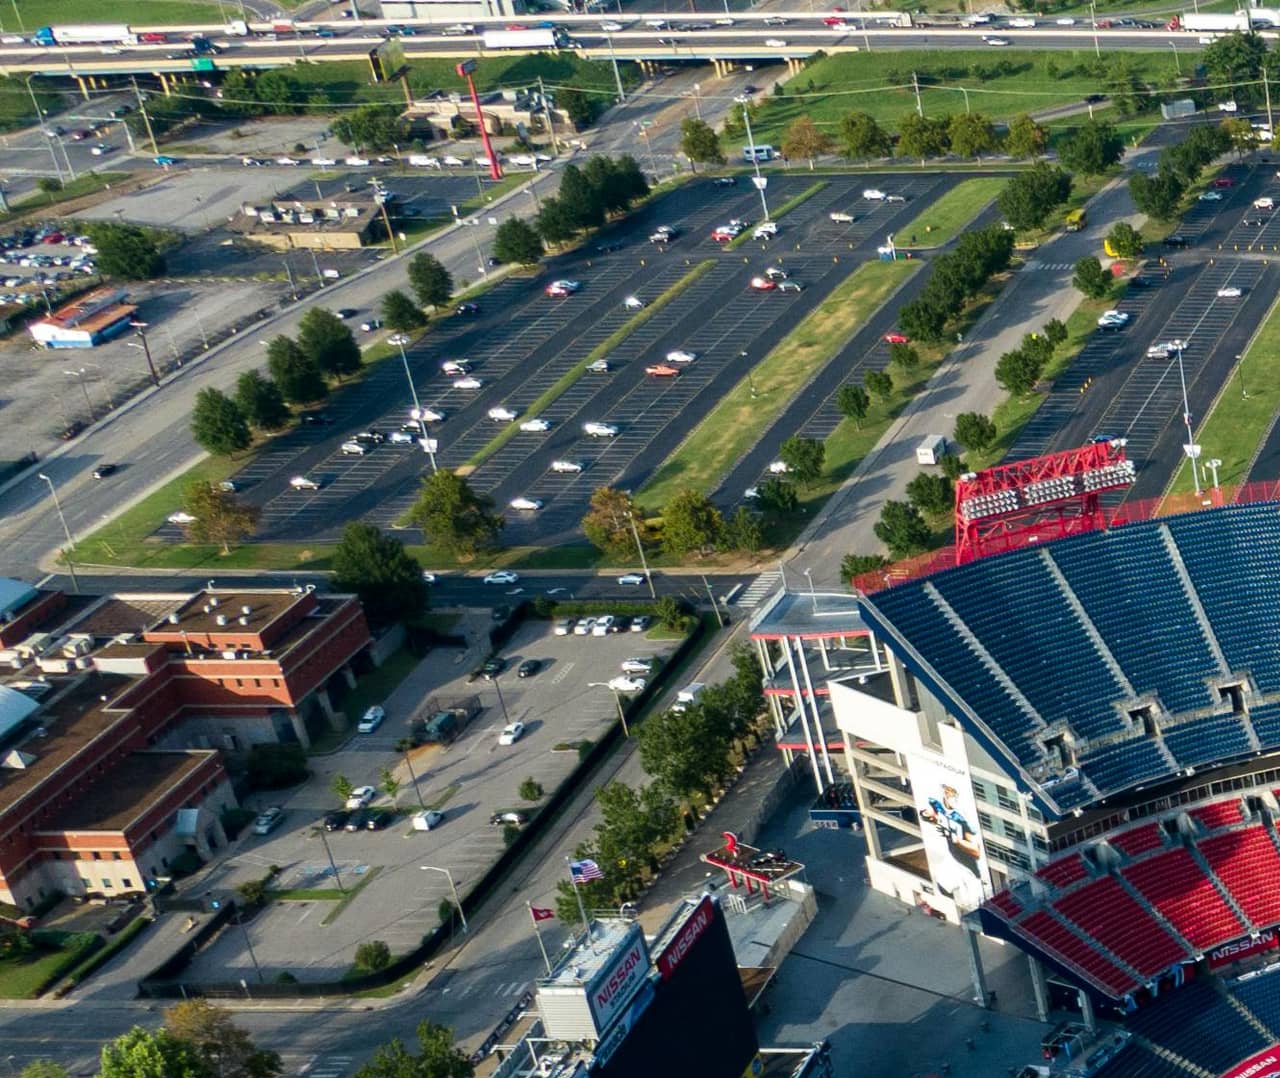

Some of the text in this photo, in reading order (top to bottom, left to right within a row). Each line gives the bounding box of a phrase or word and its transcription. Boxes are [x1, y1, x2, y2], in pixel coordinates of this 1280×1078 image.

[668, 911, 708, 969] NISSAN
[1212, 932, 1275, 961] NISSAN
[597, 947, 641, 1009] NISSAN
